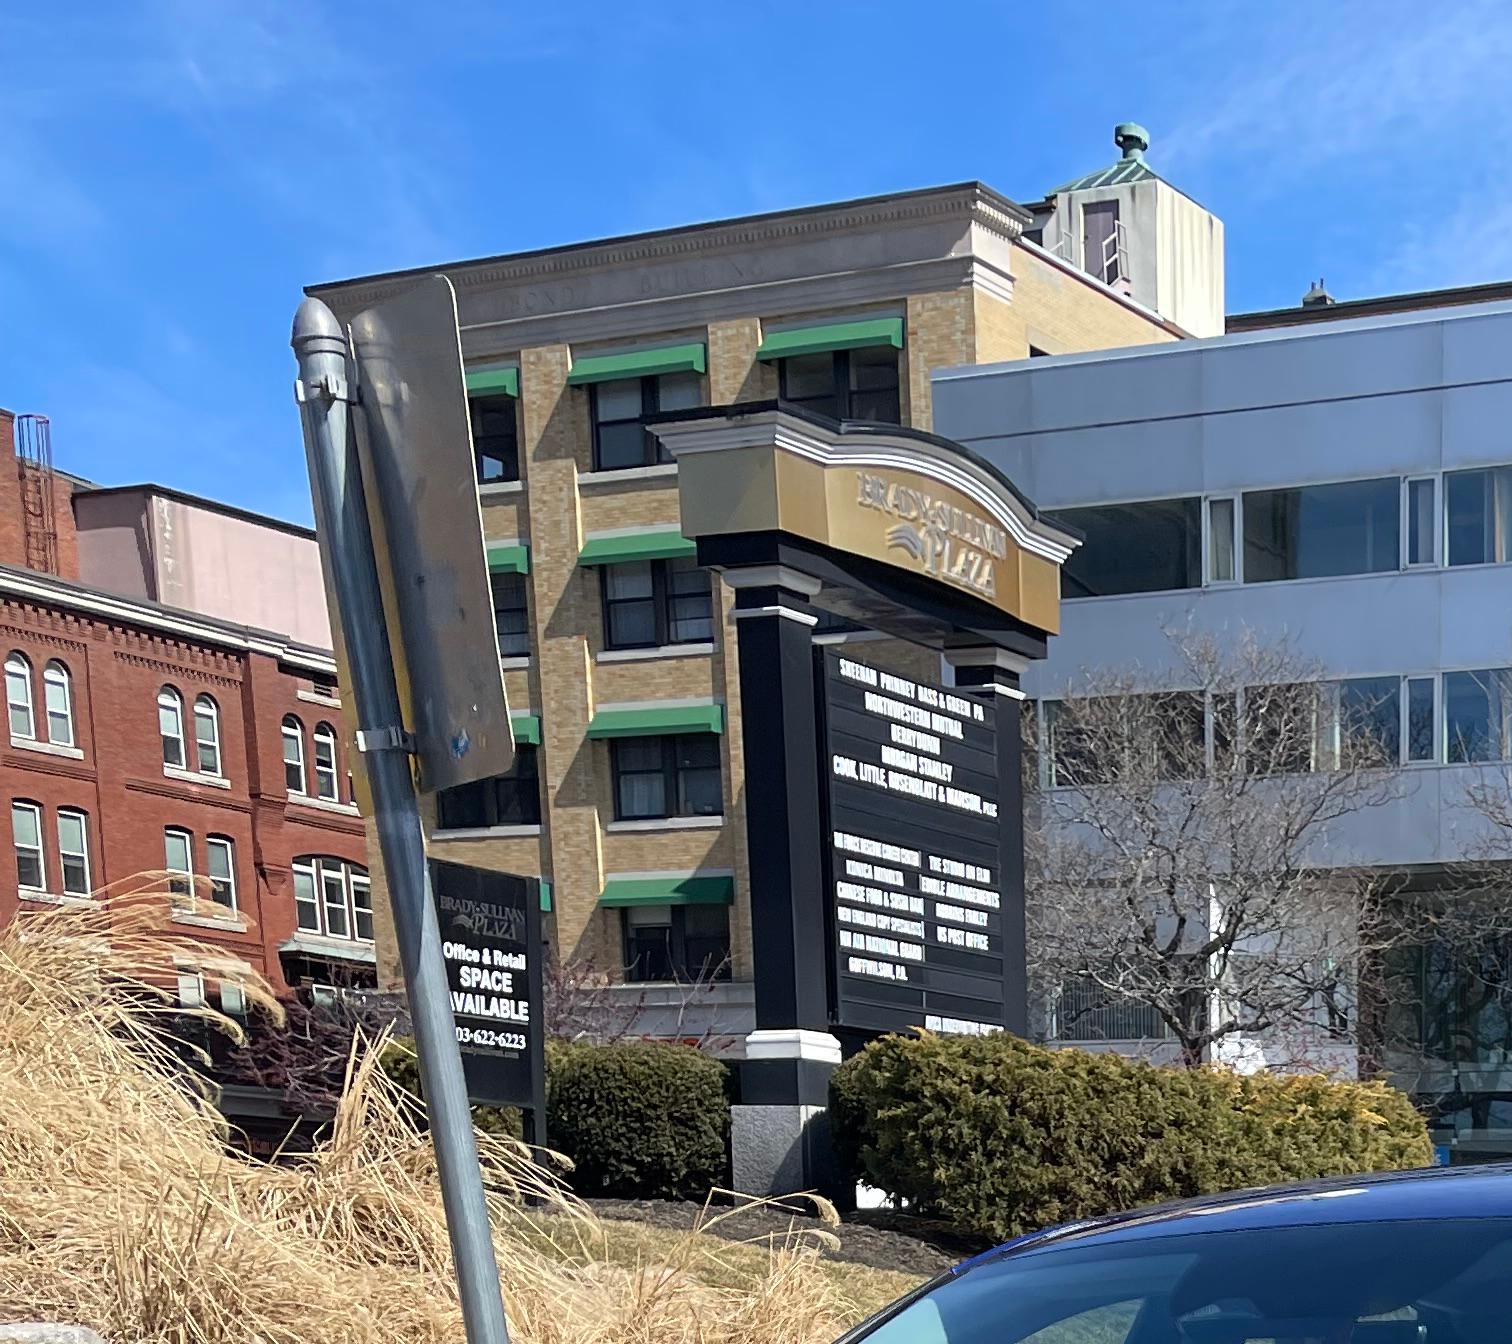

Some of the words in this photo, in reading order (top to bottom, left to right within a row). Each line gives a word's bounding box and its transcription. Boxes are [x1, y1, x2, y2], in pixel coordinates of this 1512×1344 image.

[921, 524, 997, 599] PLAZA
[918, 756, 953, 782] STANLEY
[472, 913, 517, 941] PLAZA
[443, 941, 480, 962] Office
[482, 948, 491, 965] &
[493, 949, 526, 970] Retail
[460, 966, 513, 993] SPACE
